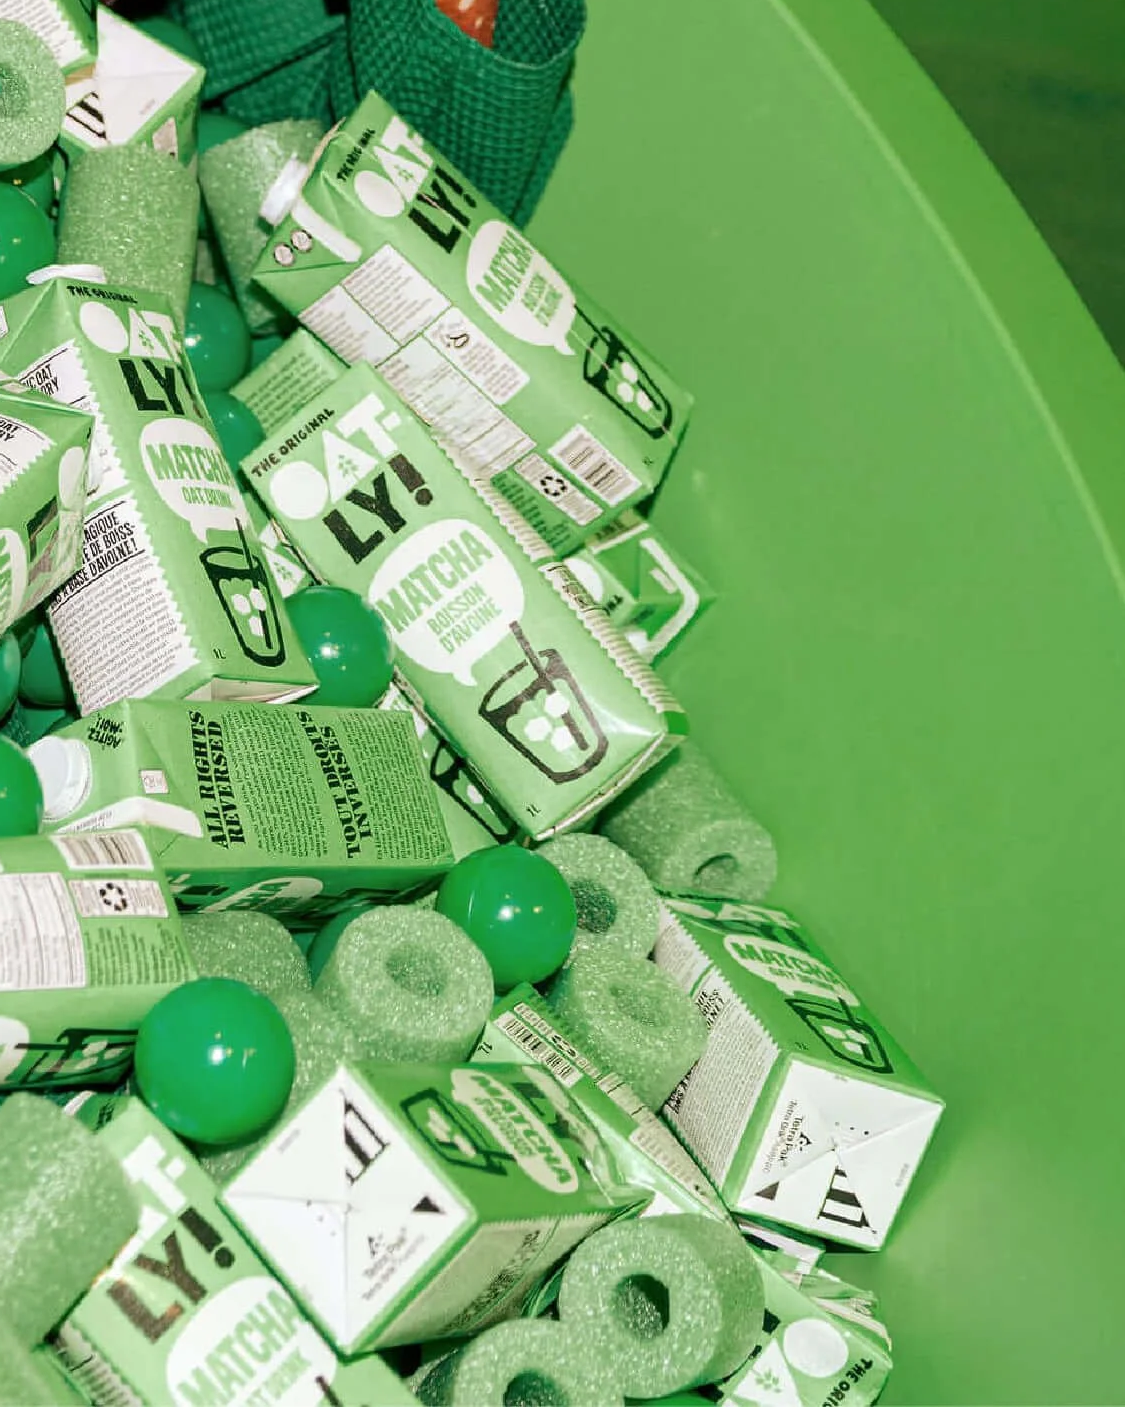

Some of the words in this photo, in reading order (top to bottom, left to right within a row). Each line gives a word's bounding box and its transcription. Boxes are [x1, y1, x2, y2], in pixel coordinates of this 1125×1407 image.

[408, 165, 477, 254] LY!
[67, 285, 92, 297] THE
[475, 229, 535, 314] MATCHA
[36, 363, 53, 386] OAT
[145, 442, 232, 486] MATCHA
[251, 452, 281, 478] THE
[278, 407, 335, 457] ORIGINAL
[84, 510, 120, 543] AGIQUE
[322, 453, 433, 565] LY!
[89, 540, 104, 557] DE
[375, 529, 494, 634] MATCHA
[426, 581, 487, 636] BOISSON
[87, 727, 122, 750] AGITEZ
[189, 710, 216, 800] RIGHTS
[296, 710, 341, 789] DROITS
[208, 720, 246, 844] REVERSED
[204, 806, 229, 850] ALL
[333, 794, 361, 859] TOUT
[730, 942, 850, 994] MATCHA
[470, 1074, 572, 1184] MATCHA
[107, 1206, 235, 1344] LY!
[177, 1289, 298, 1407] MATCHA
[845, 1357, 874, 1384] THE
